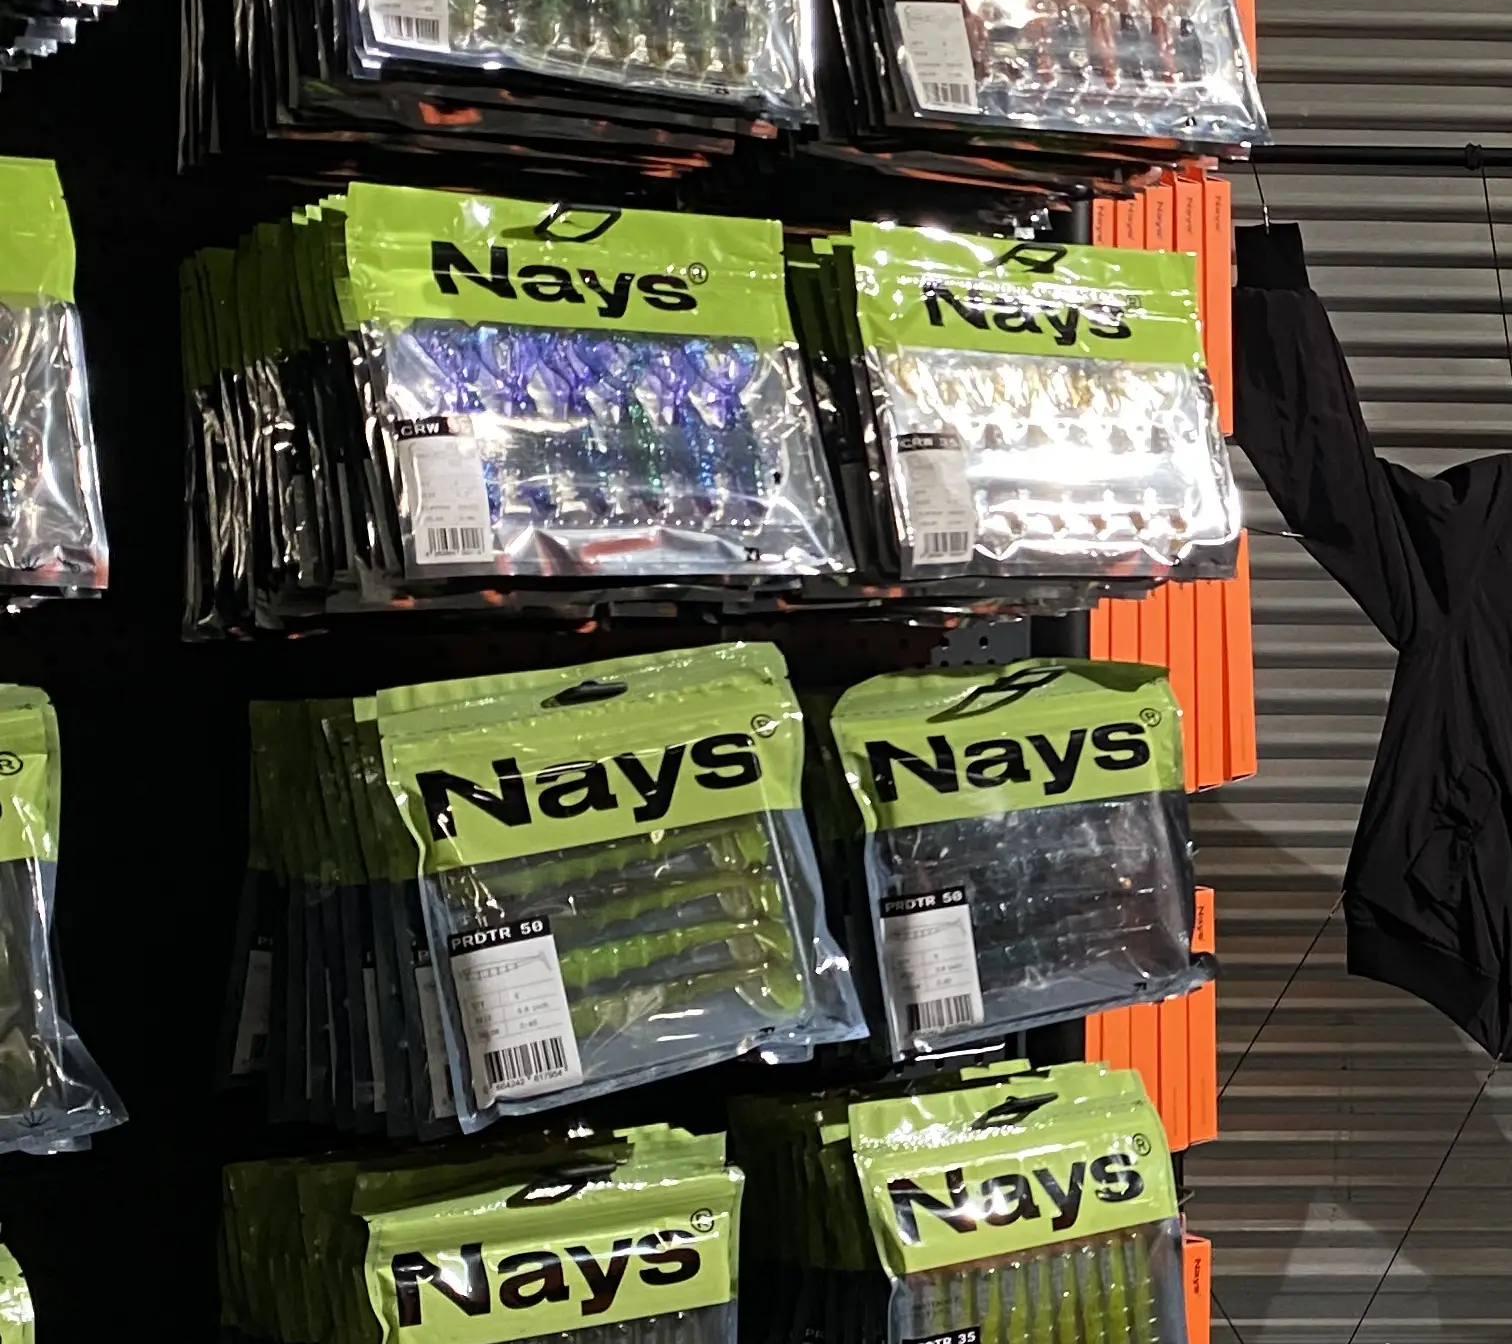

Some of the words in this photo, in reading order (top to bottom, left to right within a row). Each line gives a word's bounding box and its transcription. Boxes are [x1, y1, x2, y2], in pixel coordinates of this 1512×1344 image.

[400, 422, 440, 436] CRW
[900, 437, 934, 449] CRW
[885, 895, 936, 913] PRDTR
[942, 890, 963, 904] 50
[452, 926, 511, 950] PRDTR
[520, 920, 544, 935] 50
[957, 1331, 976, 1344] 35
